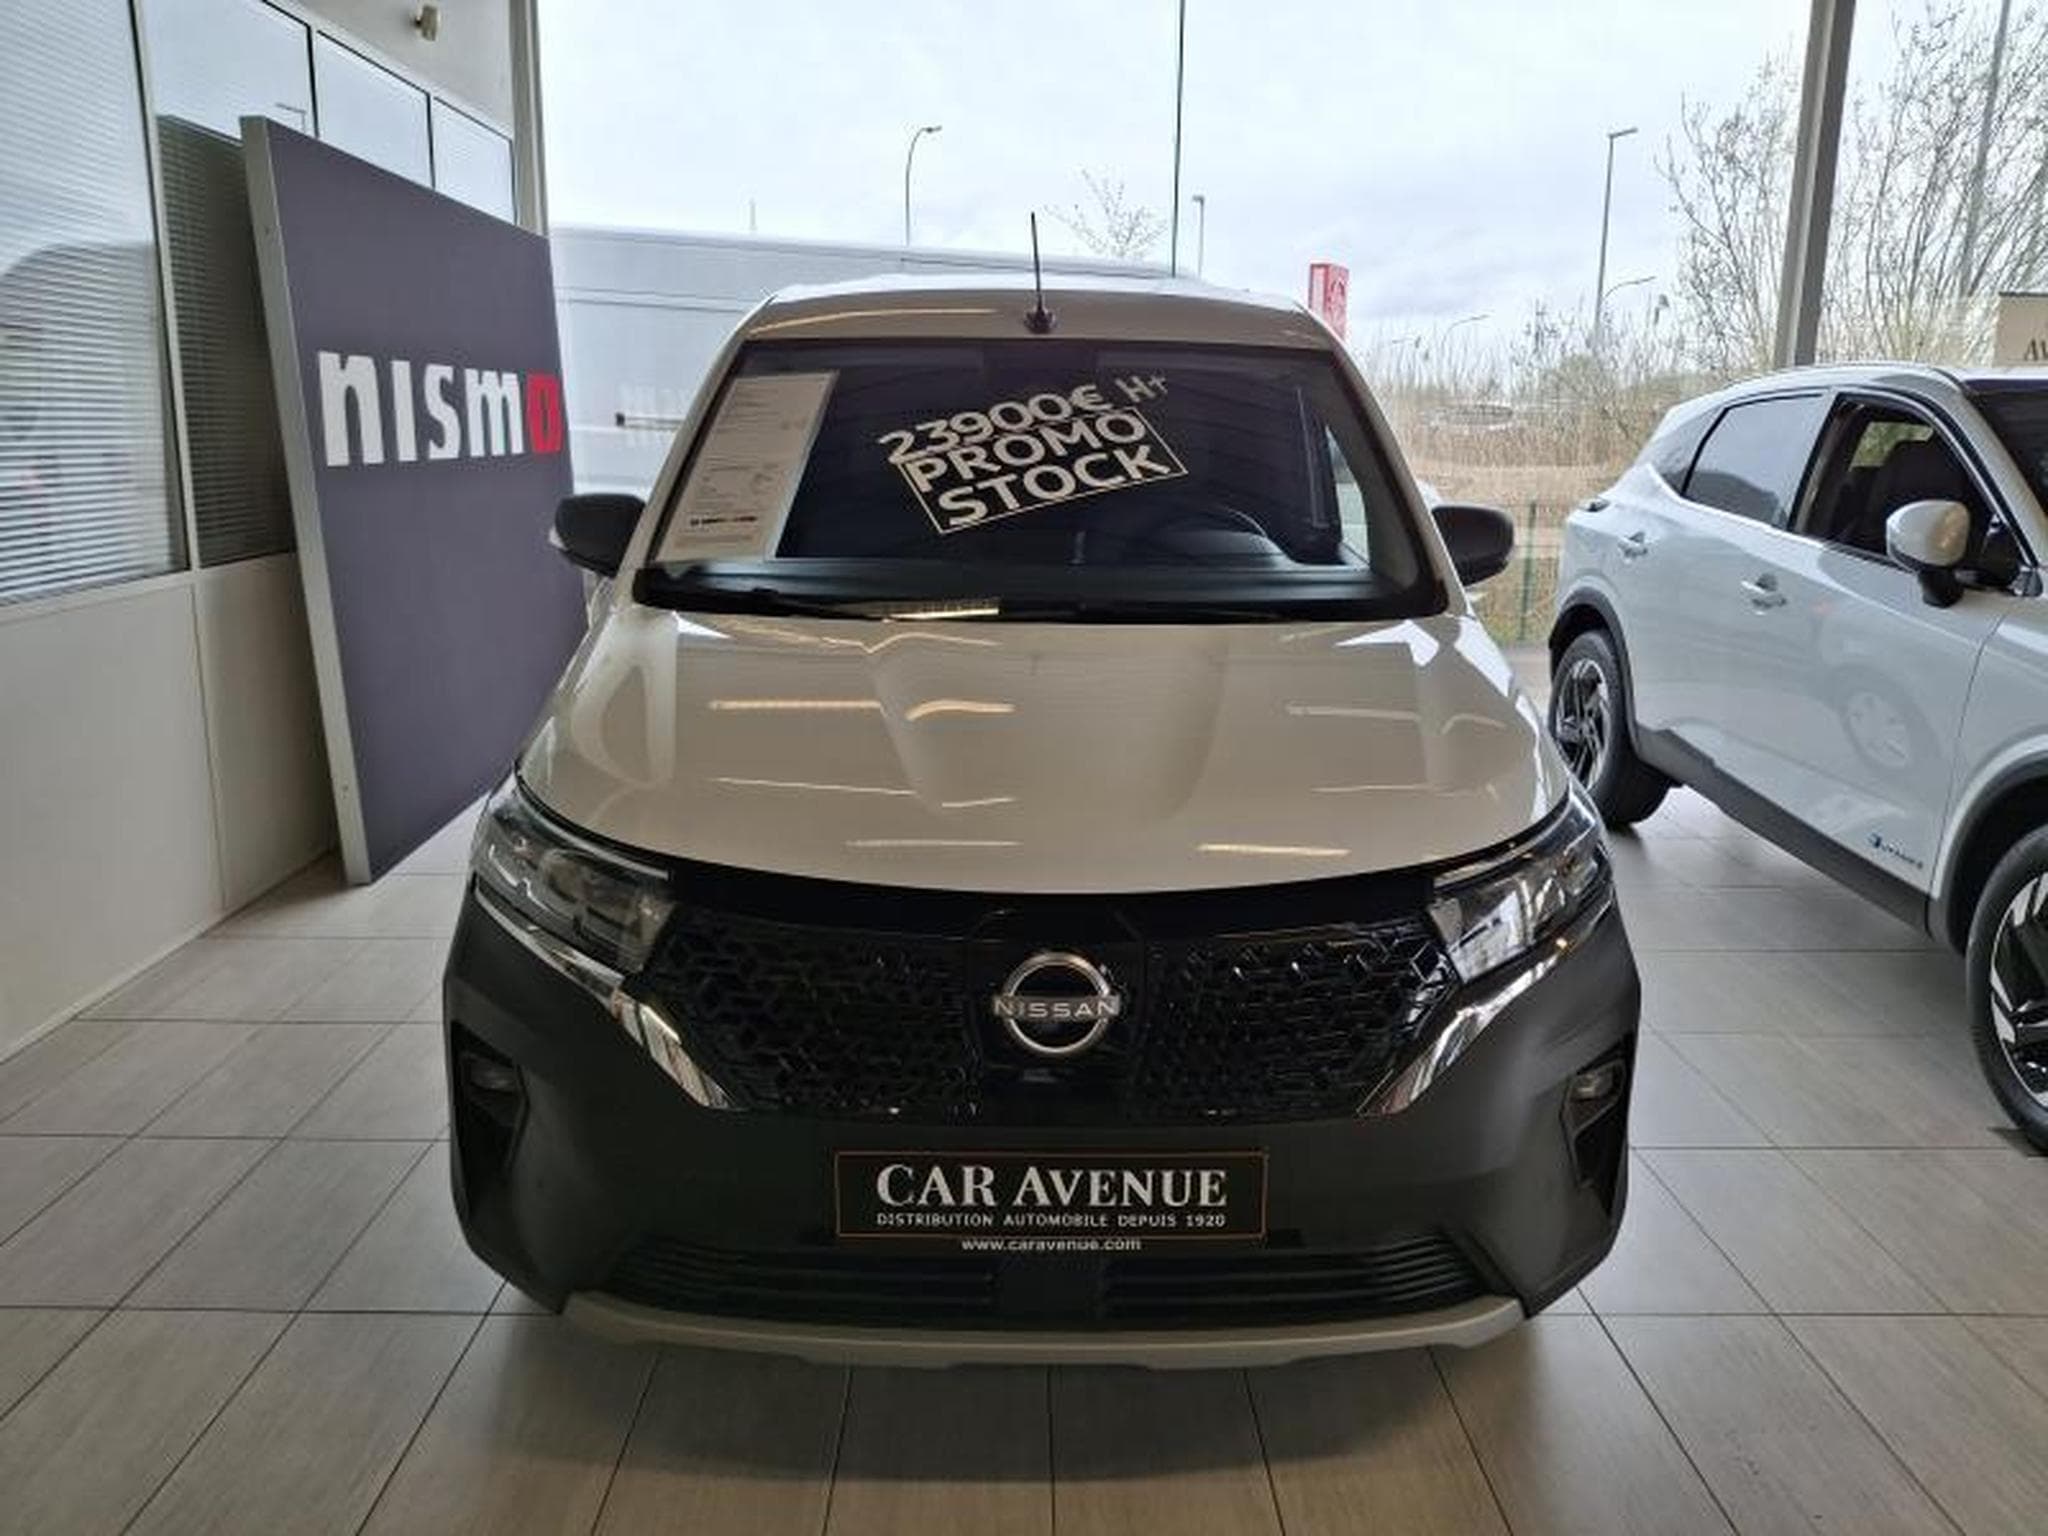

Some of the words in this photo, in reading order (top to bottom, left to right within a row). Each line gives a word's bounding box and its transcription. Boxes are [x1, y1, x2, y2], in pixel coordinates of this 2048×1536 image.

[879, 385, 1112, 464] 23900€
[903, 413, 1147, 493] PROMO
[938, 445, 1171, 526] STOCK
[992, 994, 1121, 1019] NISSAN
[877, 1163, 997, 1207] CAR
[1011, 1165, 1228, 1207] AVENUE
[876, 1212, 994, 1227] DISTRIBUTION
[1003, 1213, 1107, 1227] AUTOMOBILE
[1117, 1213, 1177, 1227] DEPUIS
[1186, 1213, 1226, 1227] 1920
[961, 1238, 1142, 1251] www.caravenue.com
